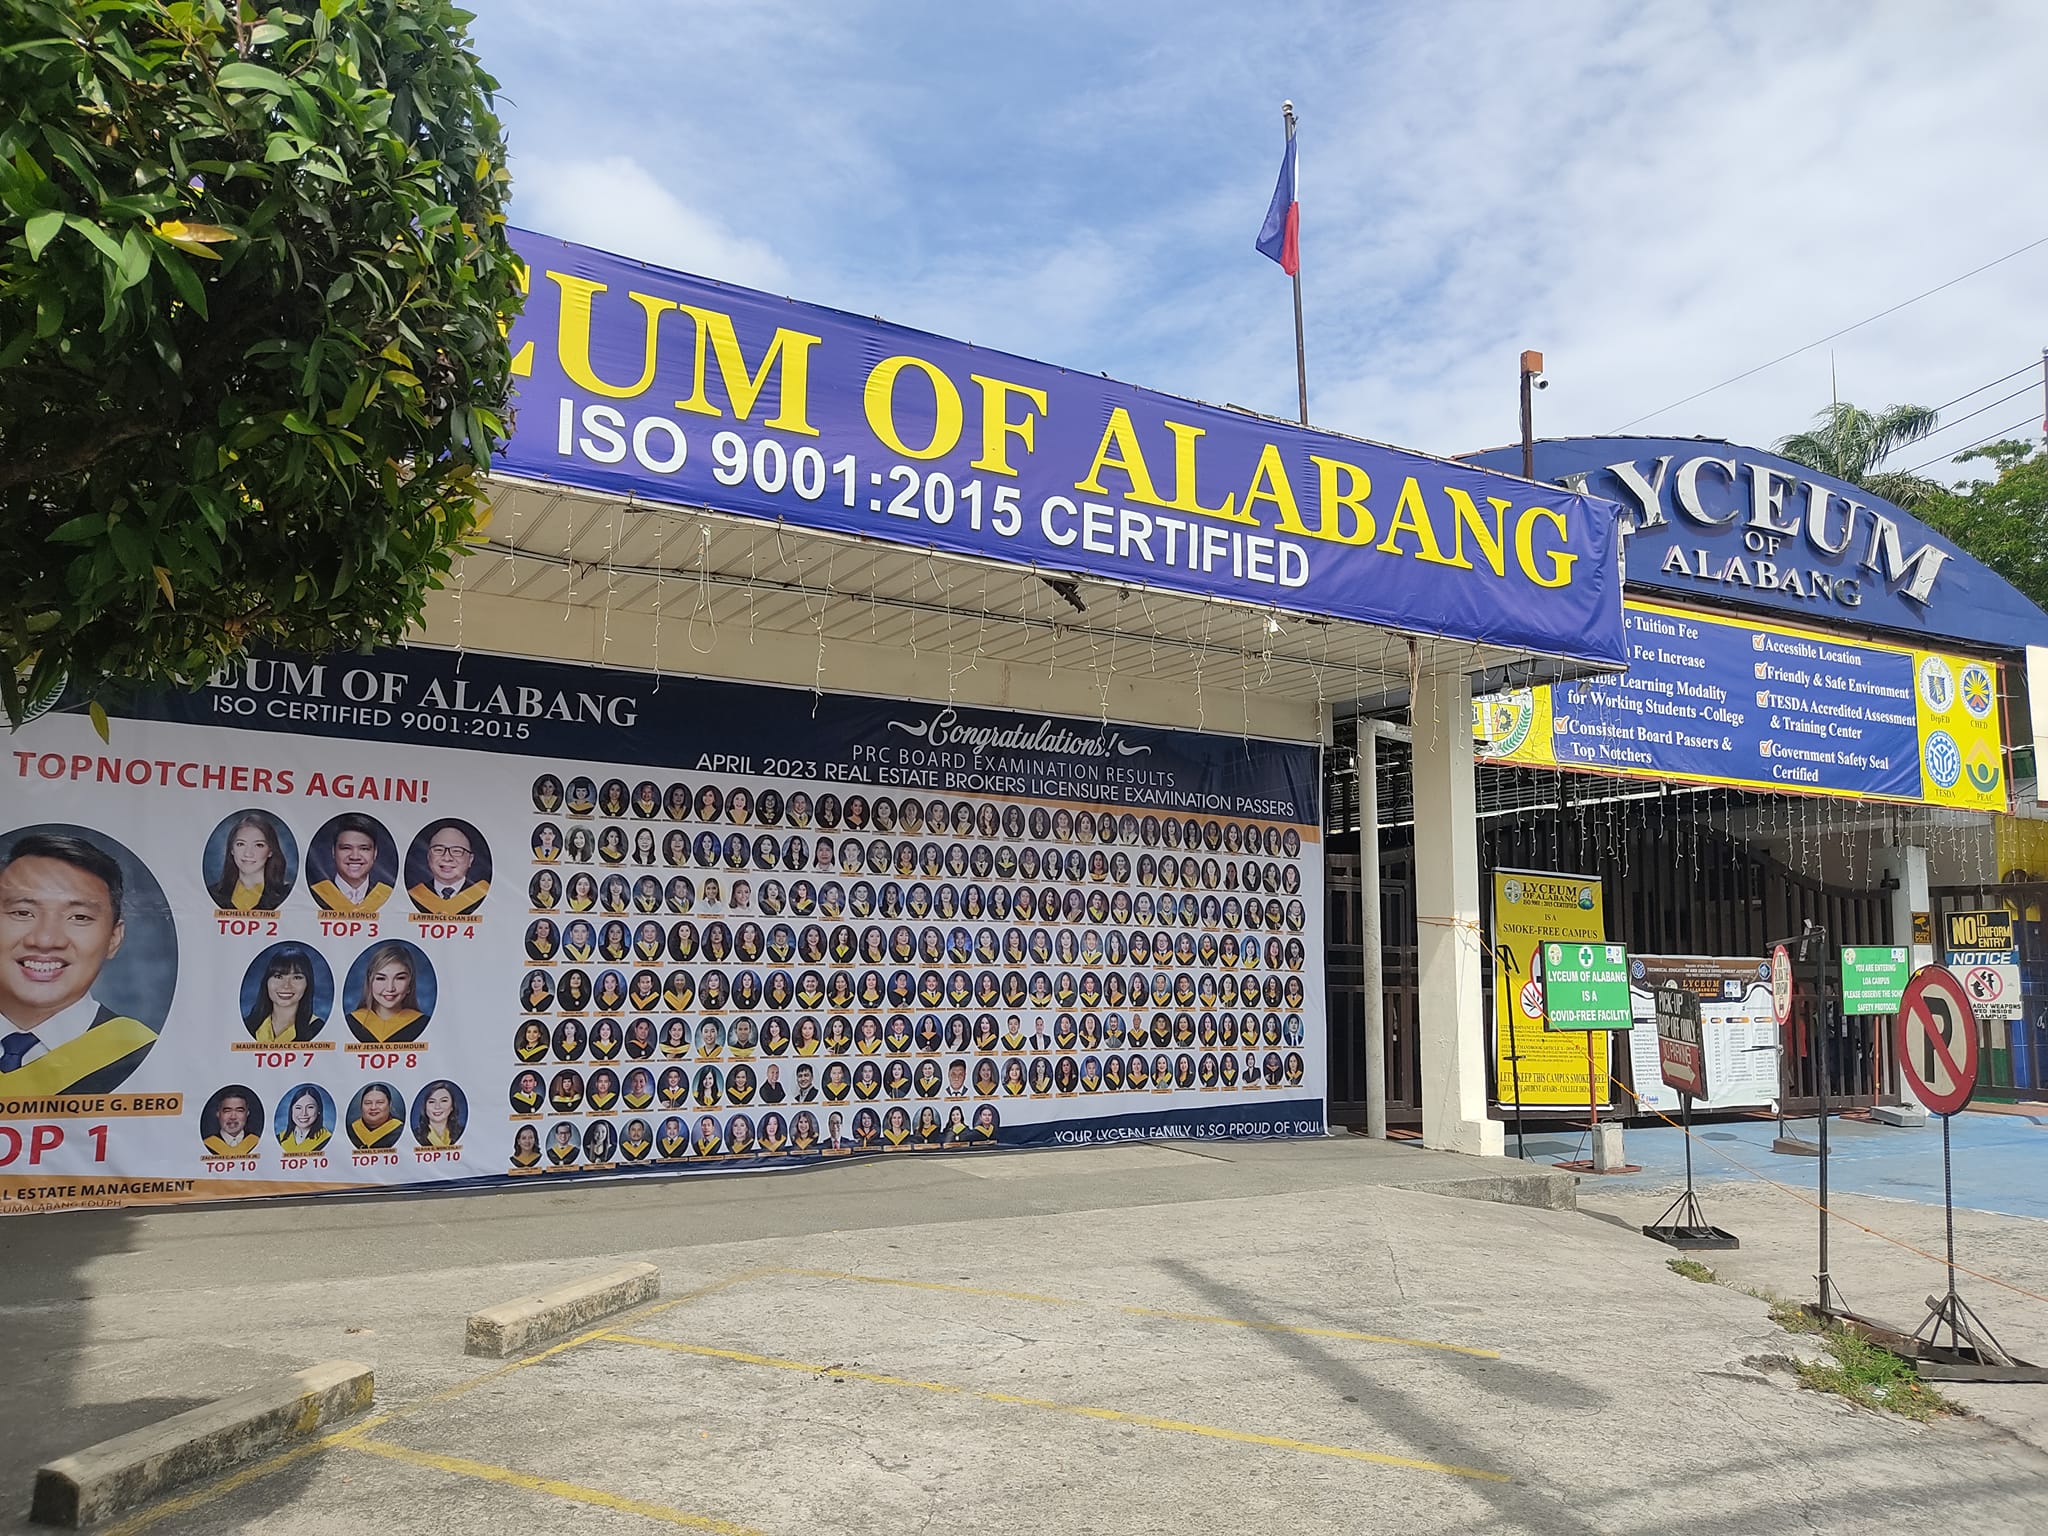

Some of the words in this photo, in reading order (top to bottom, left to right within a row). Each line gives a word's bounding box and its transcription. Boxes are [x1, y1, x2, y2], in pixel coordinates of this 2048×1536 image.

[510, 263, 822, 438] UM
[864, 355, 1048, 477] OF
[1074, 407, 1579, 588] ALABANG
[558, 397, 688, 474] ISO
[711, 430, 1023, 537] 9001:2015
[1040, 495, 1310, 588] CERTIFIED
[1744, 530, 1782, 556] OF
[1661, 544, 1864, 607] ALABANG
[1634, 615, 1676, 637] Tuition
[1678, 623, 1699, 640] Fee
[1634, 645, 1655, 661] Fee
[1658, 649, 1706, 669] Increase
[1765, 637, 1817, 660] Accessible
[1819, 647, 1862, 666] Location
[1620, 672, 1674, 697] Learning
[1676, 681, 1727, 704] Modality
[1767, 665, 1810, 688] Friendly
[1812, 673, 1823, 687] &
[1824, 675, 1847, 692] Safe
[1848, 679, 1910, 700] Environment
[206, 657, 327, 698] EUM
[342, 668, 408, 705] OF
[418, 677, 638, 728] ALABANG
[1568, 689, 1587, 705] for
[1590, 692, 1643, 715] Working
[1645, 699, 1697, 718] Students
[1699, 707, 1745, 727] -College
[1769, 694, 1809, 712] TESDA
[1810, 699, 1868, 720] Accredited
[1864, 706, 1917, 727] Assessment
[213, 694, 257, 715] ISO
[266, 700, 391, 727] CERTIFIED
[401, 711, 530, 740] 9001:2015
[927, 709, 1118, 758] Congratulations!
[1568, 719, 1635, 740] Consistent
[1637, 726, 1673, 745] Board
[1676, 731, 1719, 750] Passers
[1721, 737, 1732, 751] &
[1770, 714, 1781, 729] &
[1783, 716, 1827, 739] Training
[1828, 723, 1863, 740] Center
[1570, 742, 1596, 760] Top
[1599, 744, 1653, 764] Notchers
[1771, 743, 1836, 766] Government
[1837, 752, 1869, 771] Safety
[1869, 755, 1889, 771] Seal
[852, 744, 891, 764] PRC
[899, 749, 966, 770] BOARD
[974, 754, 1099, 781] EXAMINATION
[1106, 766, 1176, 788] RESULTS
[1772, 765, 1819, 783] Certified
[13, 751, 295, 796] TOPNOTCHERS
[306, 773, 429, 804] AGAIN!
[695, 752, 756, 775] APRIL
[763, 758, 818, 778] 2023
[825, 763, 872, 783] REAL
[879, 768, 939, 788] ESTATE
[945, 771, 1027, 794] BROKERS
[1031, 778, 1119, 801] LICENSURE
[1125, 786, 1233, 810] EXAMINATION
[1236, 796, 1295, 818] PASSERS
[1935, 788, 1956, 799] TESDA
[1522, 882, 1577, 896] LYCEUM
[1536, 893, 1577, 904] ALABANG
[218, 910, 248, 918] RICHELLE
[320, 911, 336, 919] JEYO
[348, 912, 377, 920] LEONCIO
[412, 913, 447, 921] LAWRENCE
[1976, 914, 1988, 927] ID
[217, 920, 260, 937] TOP
[266, 922, 279, 937] 2
[320, 921, 363, 937] TOP
[368, 922, 379, 938] 3
[418, 924, 458, 939] TOP
[459, 925, 475, 939] 4
[1503, 923, 1560, 937] SMOKE-FREE
[1561, 928, 1598, 939] CAMPUS
[1951, 917, 1977, 945] NO
[1977, 926, 2010, 938] UNIFORM
[1978, 937, 2006, 948] ENTRY
[1952, 952, 2011, 965] NOTICE
[1548, 971, 1579, 982] LYCEUM
[1580, 972, 1591, 982] OF
[1592, 971, 1627, 982] ALABANG
[1874, 964, 1897, 972] ENTERING
[1682, 980, 1720, 988] LYCEUM
[1581, 990, 1591, 1001] IS
[1592, 991, 1598, 1001] A
[1658, 990, 1683, 1015] PICK-UP
[1861, 990, 1882, 998] OBSERVE
[1882, 990, 1891, 998] THE
[1550, 1010, 1596, 1022] COVID-FREE
[1597, 1009, 1630, 1021] FACILITY
[1857, 1003, 1874, 1011] SAFETY
[1670, 1016, 1680, 1039] OFF
[1680, 1018, 1696, 1043] ONLY
[254, 1053, 297, 1068] TOP
[303, 1053, 315, 1068] 7
[357, 1053, 400, 1069] TOP
[405, 1053, 417, 1068] 8
[1533, 1073, 1546, 1083] THIS
[1547, 1073, 1570, 1083] CAMPUS
[110, 1098, 127, 1112] G.
[133, 1097, 179, 1112] BERO
[1054, 1129, 1092, 1143] YOUR
[1096, 1127, 1146, 1141] LYCEAN
[1149, 1124, 1193, 1138] FAMILY
[1196, 1124, 1205, 1137] IS
[1208, 1123, 1226, 1136] SO
[1229, 1121, 1270, 1135] PROUD
[1274, 1120, 1290, 1134] OF
[1293, 1120, 1320, 1134] YOU!
[0, 1124, 65, 1167] OP
[88, 1124, 109, 1162] 1
[280, 1158, 308, 1170] TOP
[312, 1158, 328, 1169] 10
[352, 1155, 379, 1167] TOP
[383, 1155, 399, 1165] 10
[415, 1152, 441, 1163] TOP
[445, 1151, 460, 1162] 10
[206, 1161, 235, 1173] TOP
[240, 1161, 256, 1172] 10
[17, 1186, 76, 1200] ESTATE
[80, 1180, 195, 1196] MANAGEMENT
